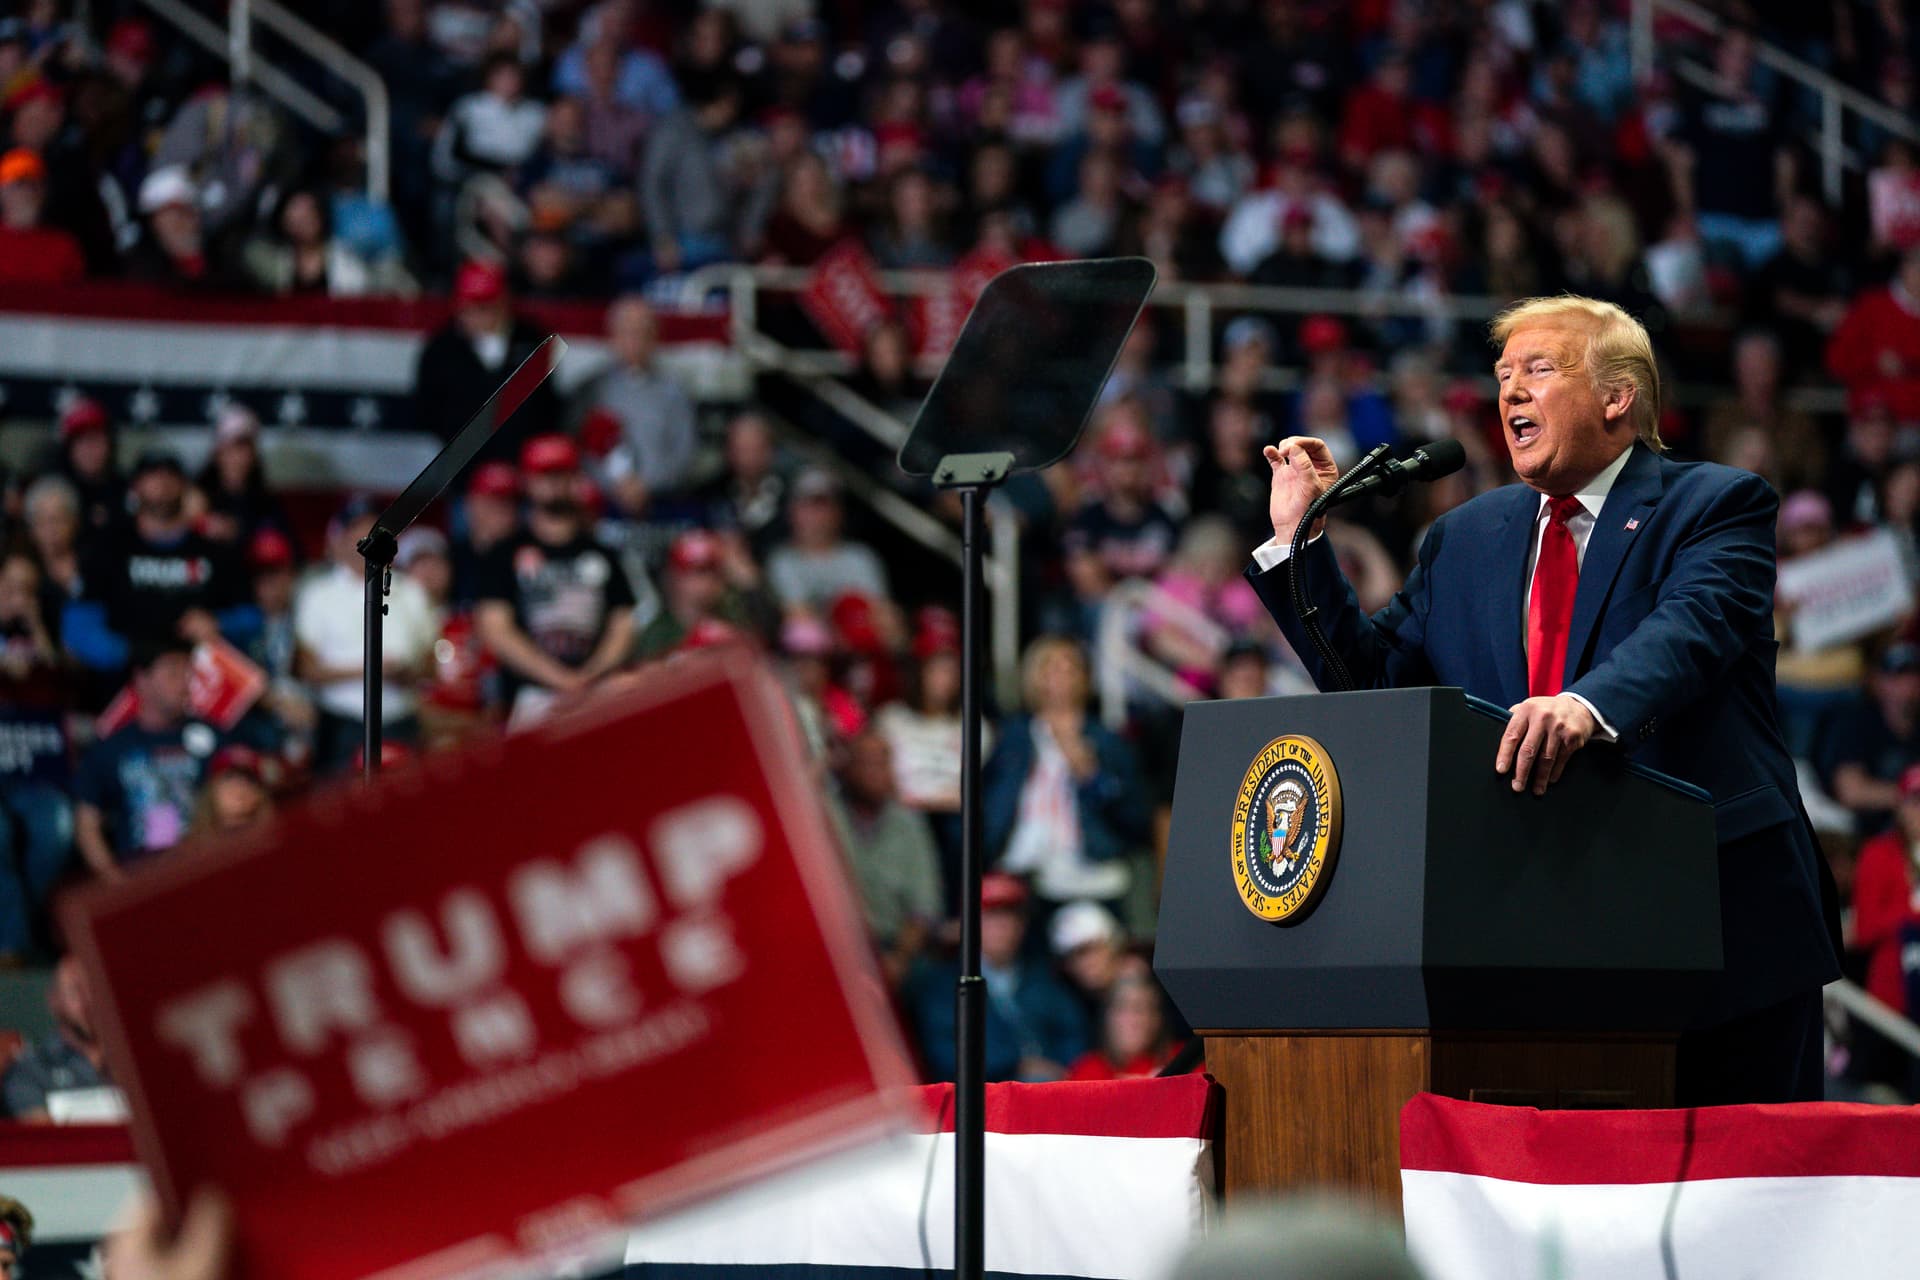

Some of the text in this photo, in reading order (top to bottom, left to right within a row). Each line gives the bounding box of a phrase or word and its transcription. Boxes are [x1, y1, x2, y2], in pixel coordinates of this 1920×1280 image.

[1288, 744, 1299, 756] OF
[1300, 747, 1313, 765] THE
[1236, 742, 1287, 825] PRESIDENT
[1312, 762, 1329, 838] UNITED
[1235, 831, 1244, 857] THE
[1236, 860, 1245, 876] OF
[1282, 855, 1321, 912] STATES
[1242, 875, 1265, 912] SEAL
[155, 796, 765, 1087] TRUMP
